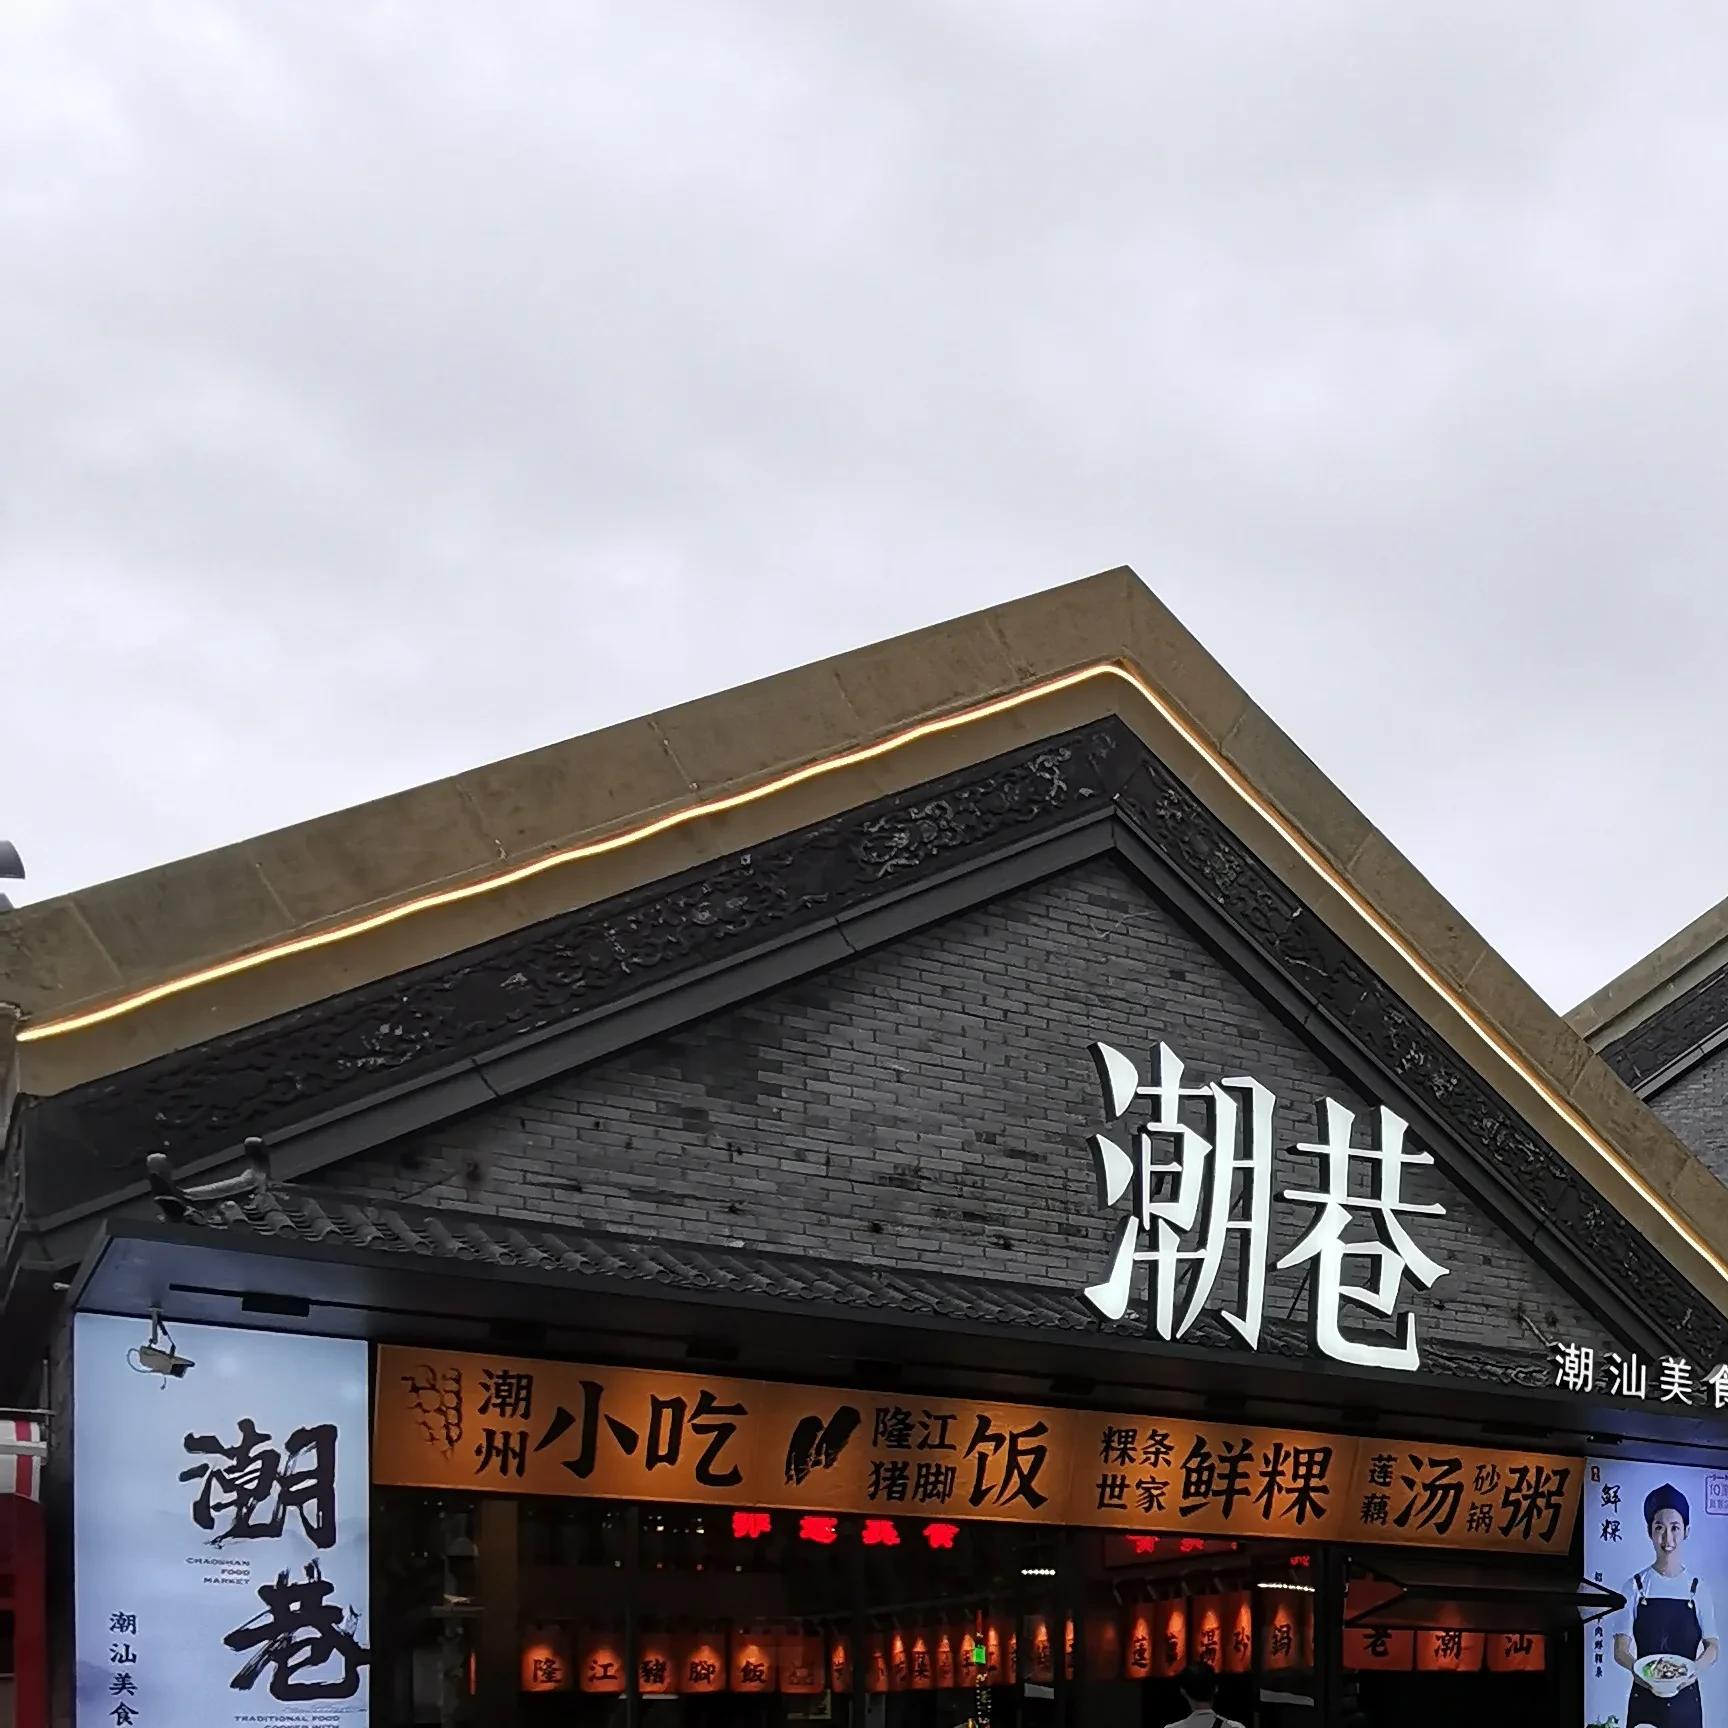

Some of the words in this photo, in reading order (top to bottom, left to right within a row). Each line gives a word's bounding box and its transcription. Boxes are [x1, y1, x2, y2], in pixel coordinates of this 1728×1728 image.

[1083, 1041, 1451, 1371] 潮巷
[474, 1368, 533, 1478] 潮州
[533, 1380, 749, 1487] 小吃
[872, 1406, 958, 1450] 隆江
[962, 1413, 1049, 1510] 饭
[1100, 1425, 1175, 1468] 粿条
[1179, 1434, 1333, 1526] 鲜粿
[868, 1460, 957, 1504] 猪脚
[1095, 1473, 1170, 1514] 世家
[178, 1418, 370, 1702] 潮巷
